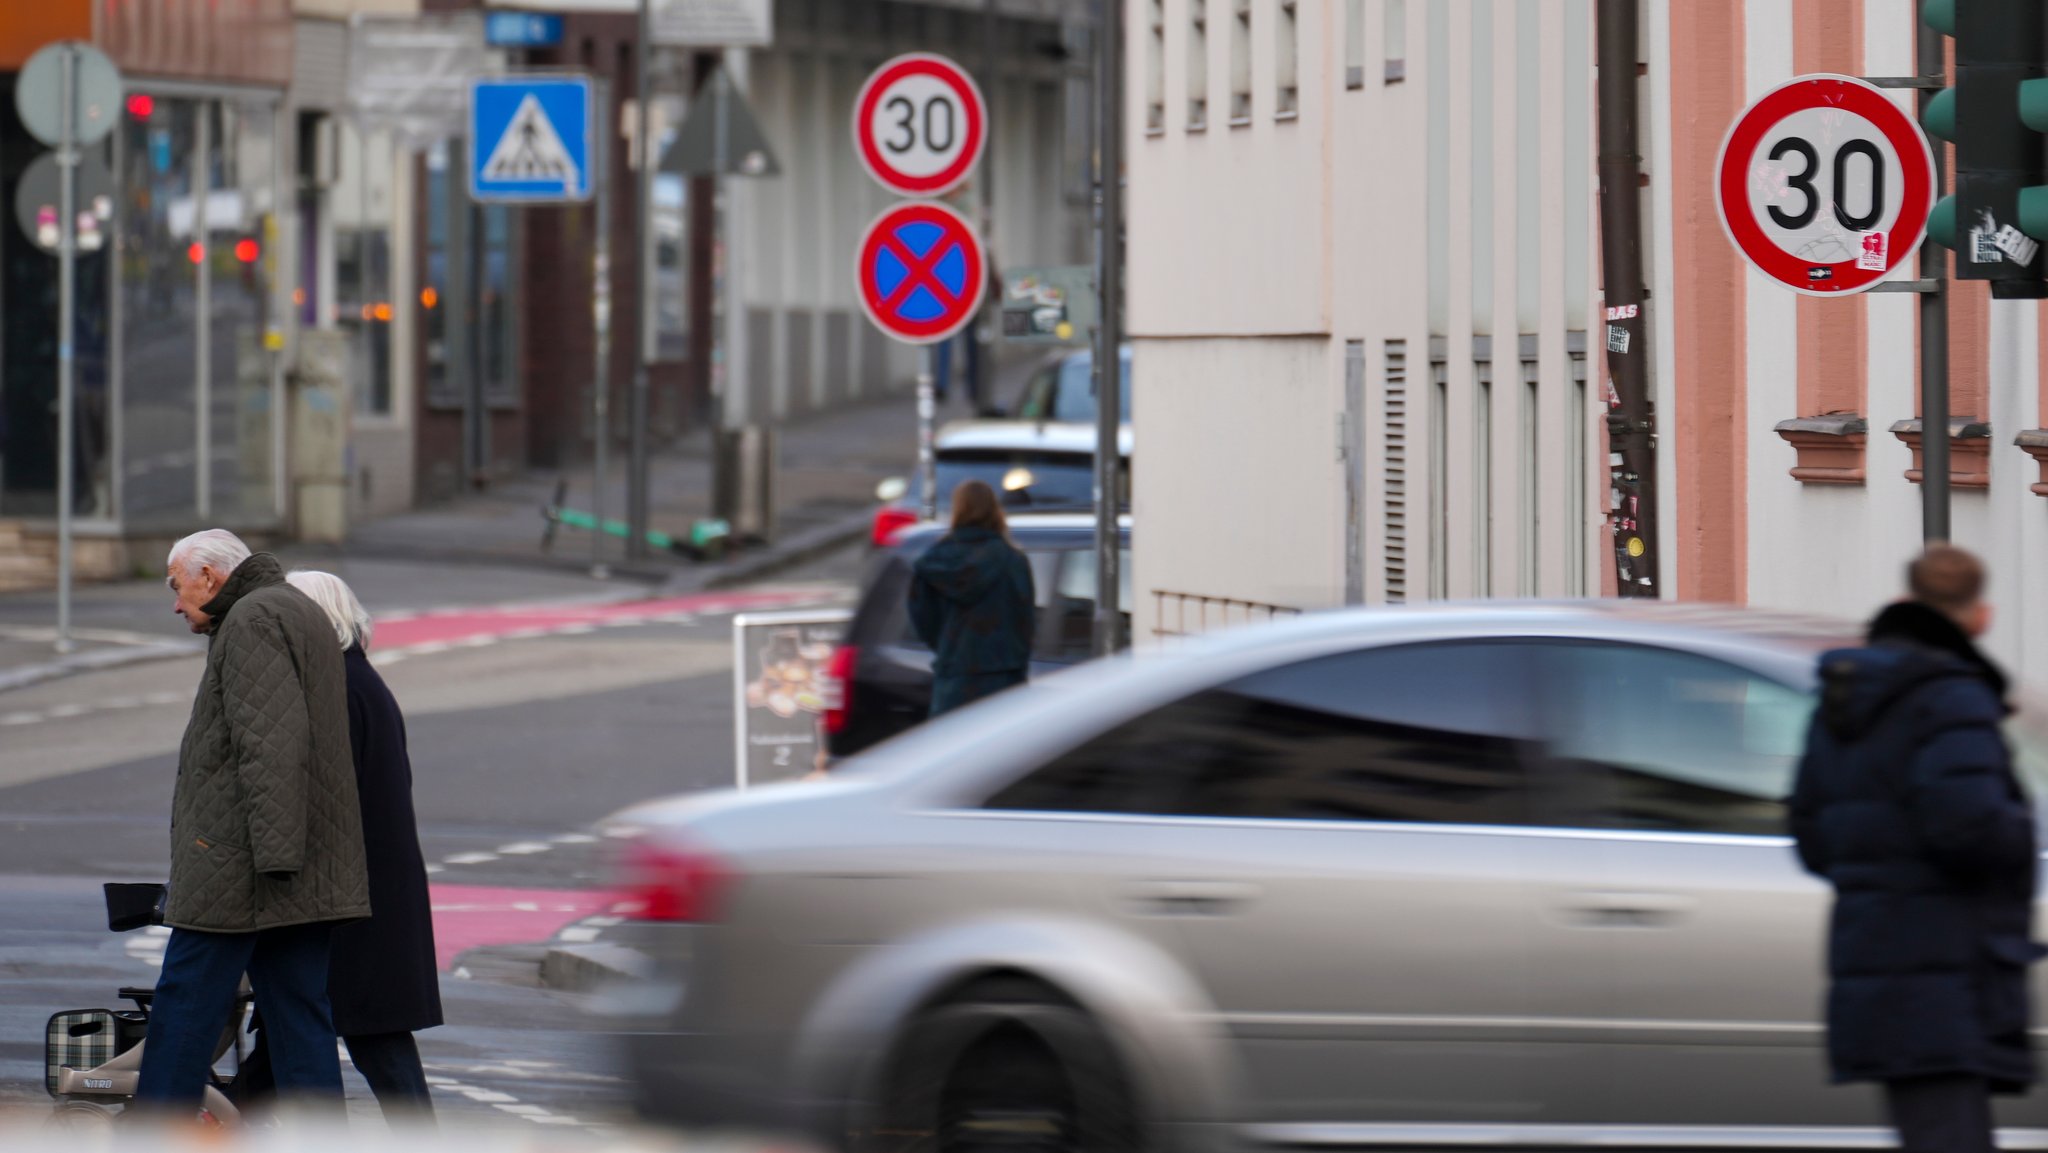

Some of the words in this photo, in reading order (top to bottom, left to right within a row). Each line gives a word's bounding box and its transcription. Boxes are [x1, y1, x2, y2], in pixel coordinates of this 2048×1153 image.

[885, 96, 954, 153] 30
[1766, 136, 1885, 232] 30
[1610, 335, 1626, 344] EINS
[1609, 342, 1626, 352] NULL
[82, 1078, 113, 1089] NITRO
